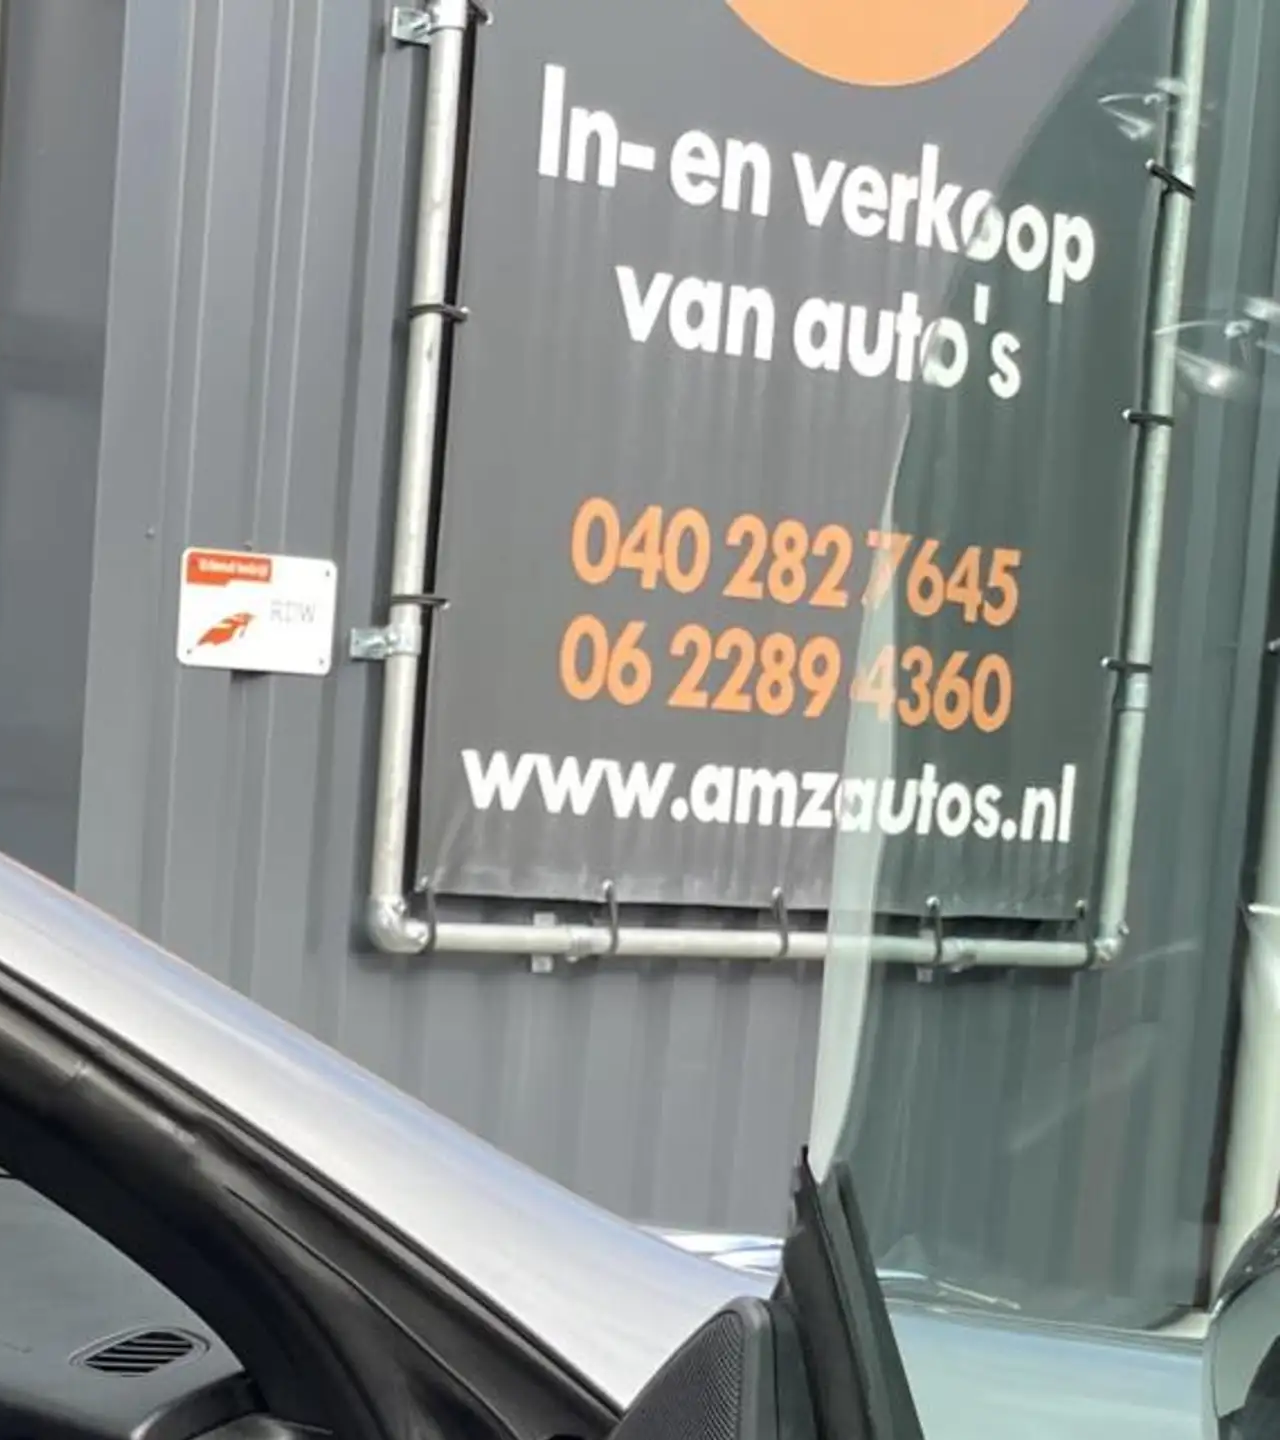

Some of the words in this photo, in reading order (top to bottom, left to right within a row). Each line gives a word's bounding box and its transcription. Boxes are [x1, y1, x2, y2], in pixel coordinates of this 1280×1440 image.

[538, 63, 657, 188] In-
[669, 129, 773, 217] en
[792, 143, 1096, 304] verkoop
[614, 265, 776, 361] van
[793, 291, 1022, 399] auto's
[570, 497, 711, 593] 040
[724, 513, 853, 609] 282
[861, 529, 1022, 626] 7645
[559, 613, 653, 706] 06
[668, 623, 842, 719] 2289
[850, 643, 1013, 733] 4360
[461, 749, 1077, 843] www.amzautos.nl
